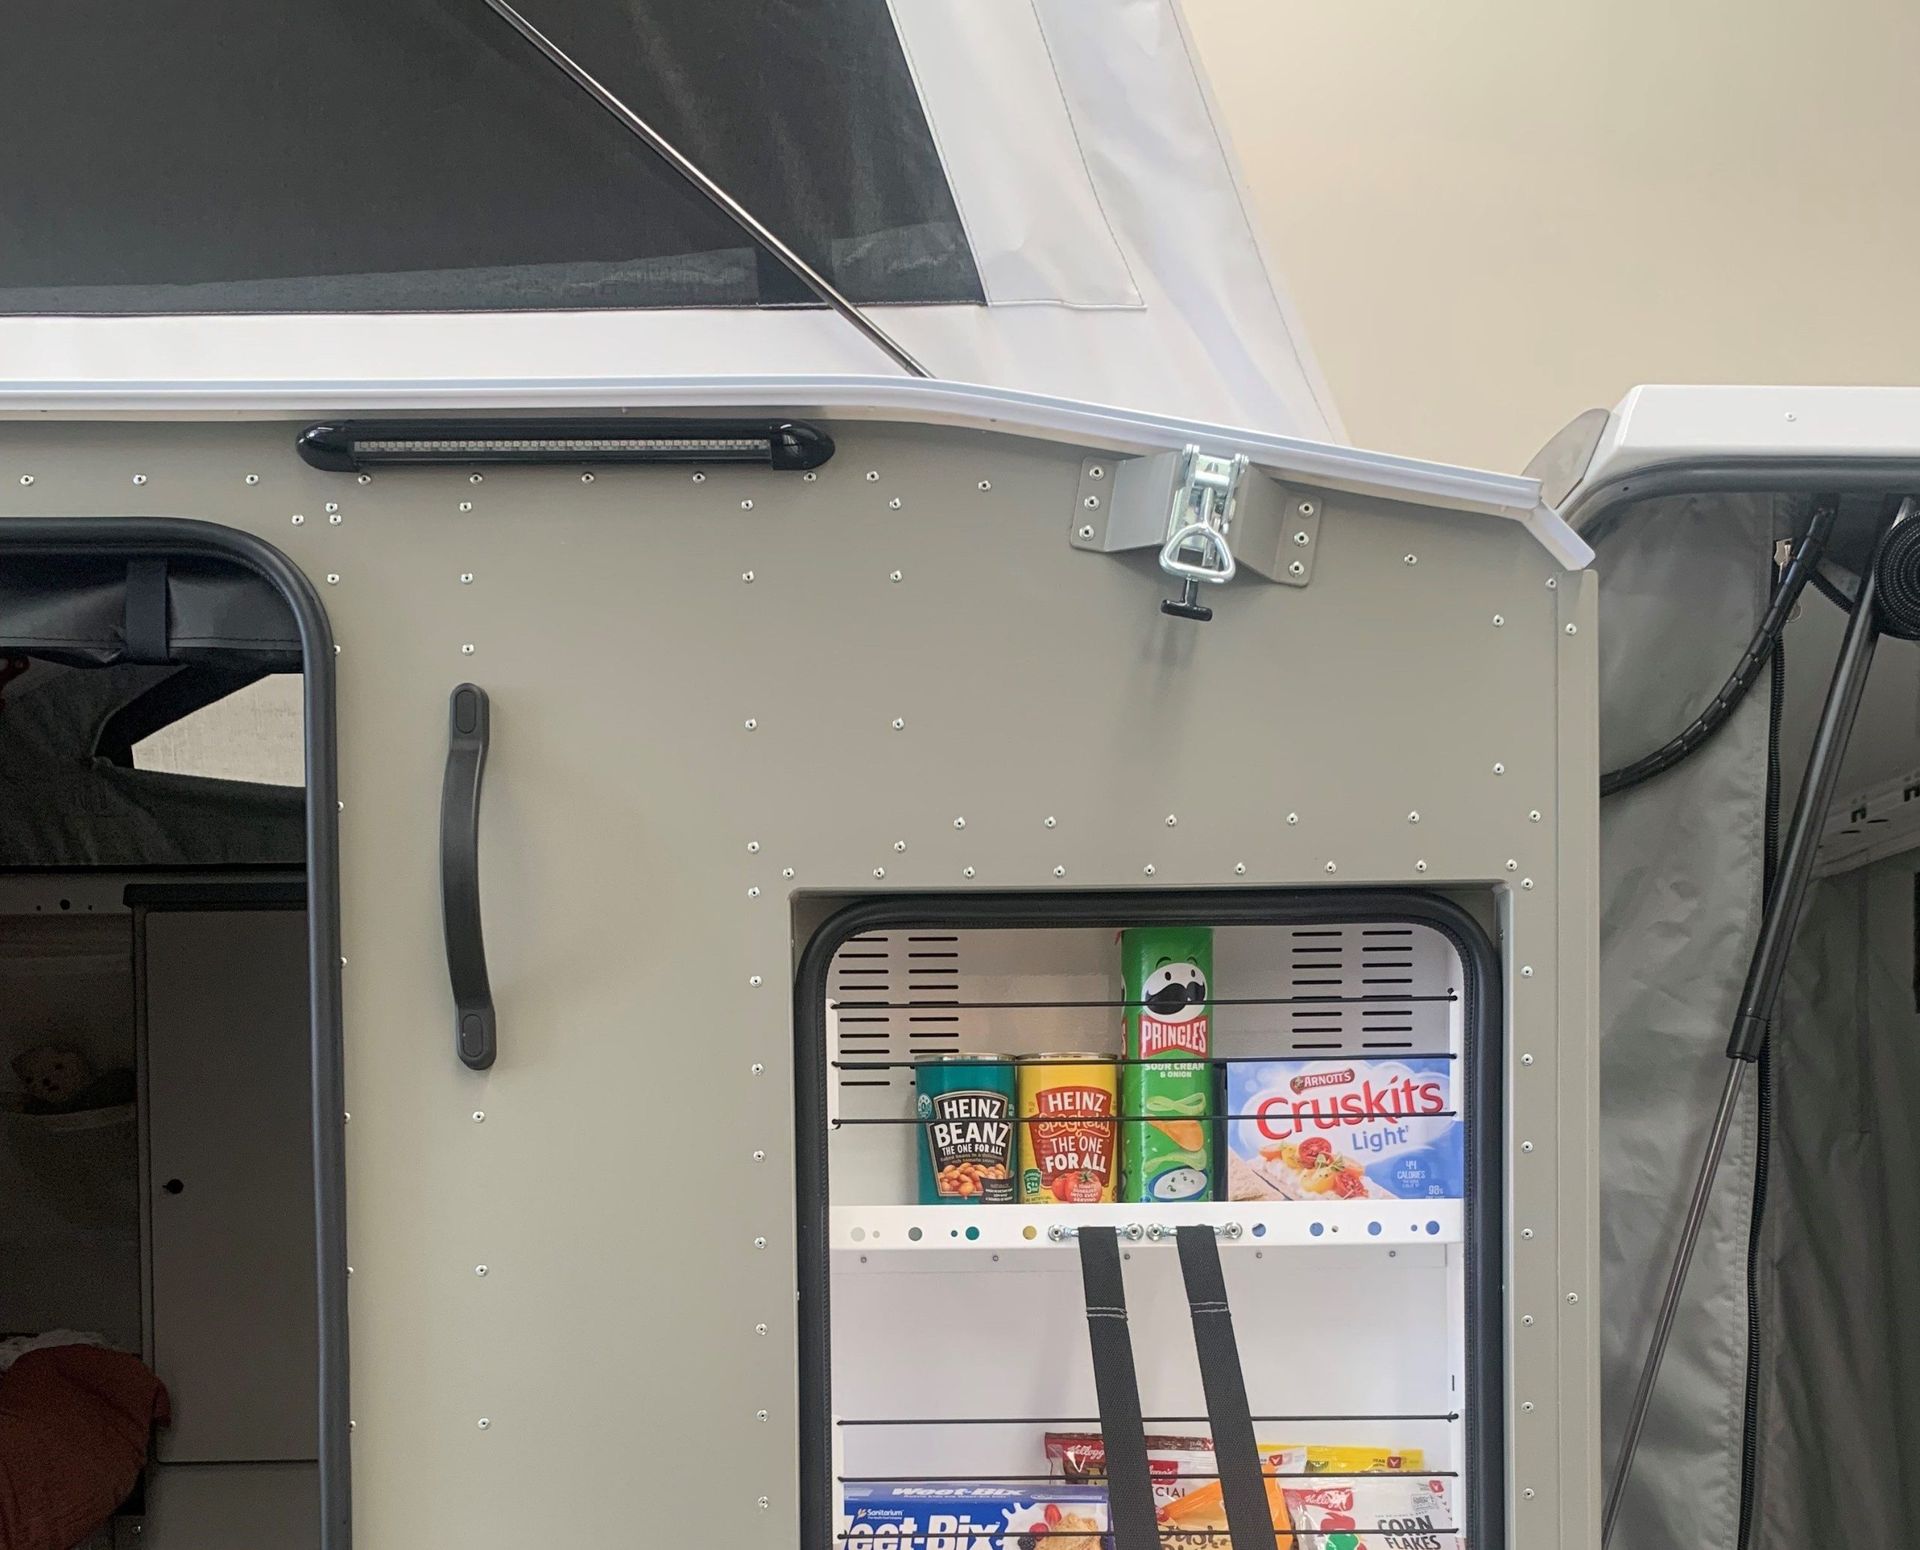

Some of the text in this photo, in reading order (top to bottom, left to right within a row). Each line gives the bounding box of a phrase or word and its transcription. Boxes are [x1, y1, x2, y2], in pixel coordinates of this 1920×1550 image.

[1141, 1020, 1206, 1056] PRINGLES
[1145, 1062, 1171, 1071] SOUR
[943, 1098, 1001, 1119] HEINZ
[1048, 1091, 1104, 1113] HEINZ
[1256, 1074, 1444, 1140] Cruskits
[934, 1121, 1010, 1148] BEANZ
[1352, 1126, 1409, 1152] Light
[942, 1143, 1003, 1156] THE ONE FOR ALL
[1050, 1136, 1104, 1154] THE ONE
[1045, 1153, 1106, 1173] FOR ALL
[1396, 1170, 1426, 1180] CALORIES
[892, 1488, 1026, 1496] Weet-Bix
[867, 1508, 902, 1517] Sanitarium
[1377, 1514, 1434, 1536] CORN
[1384, 1534, 1442, 1550] FLAKES
